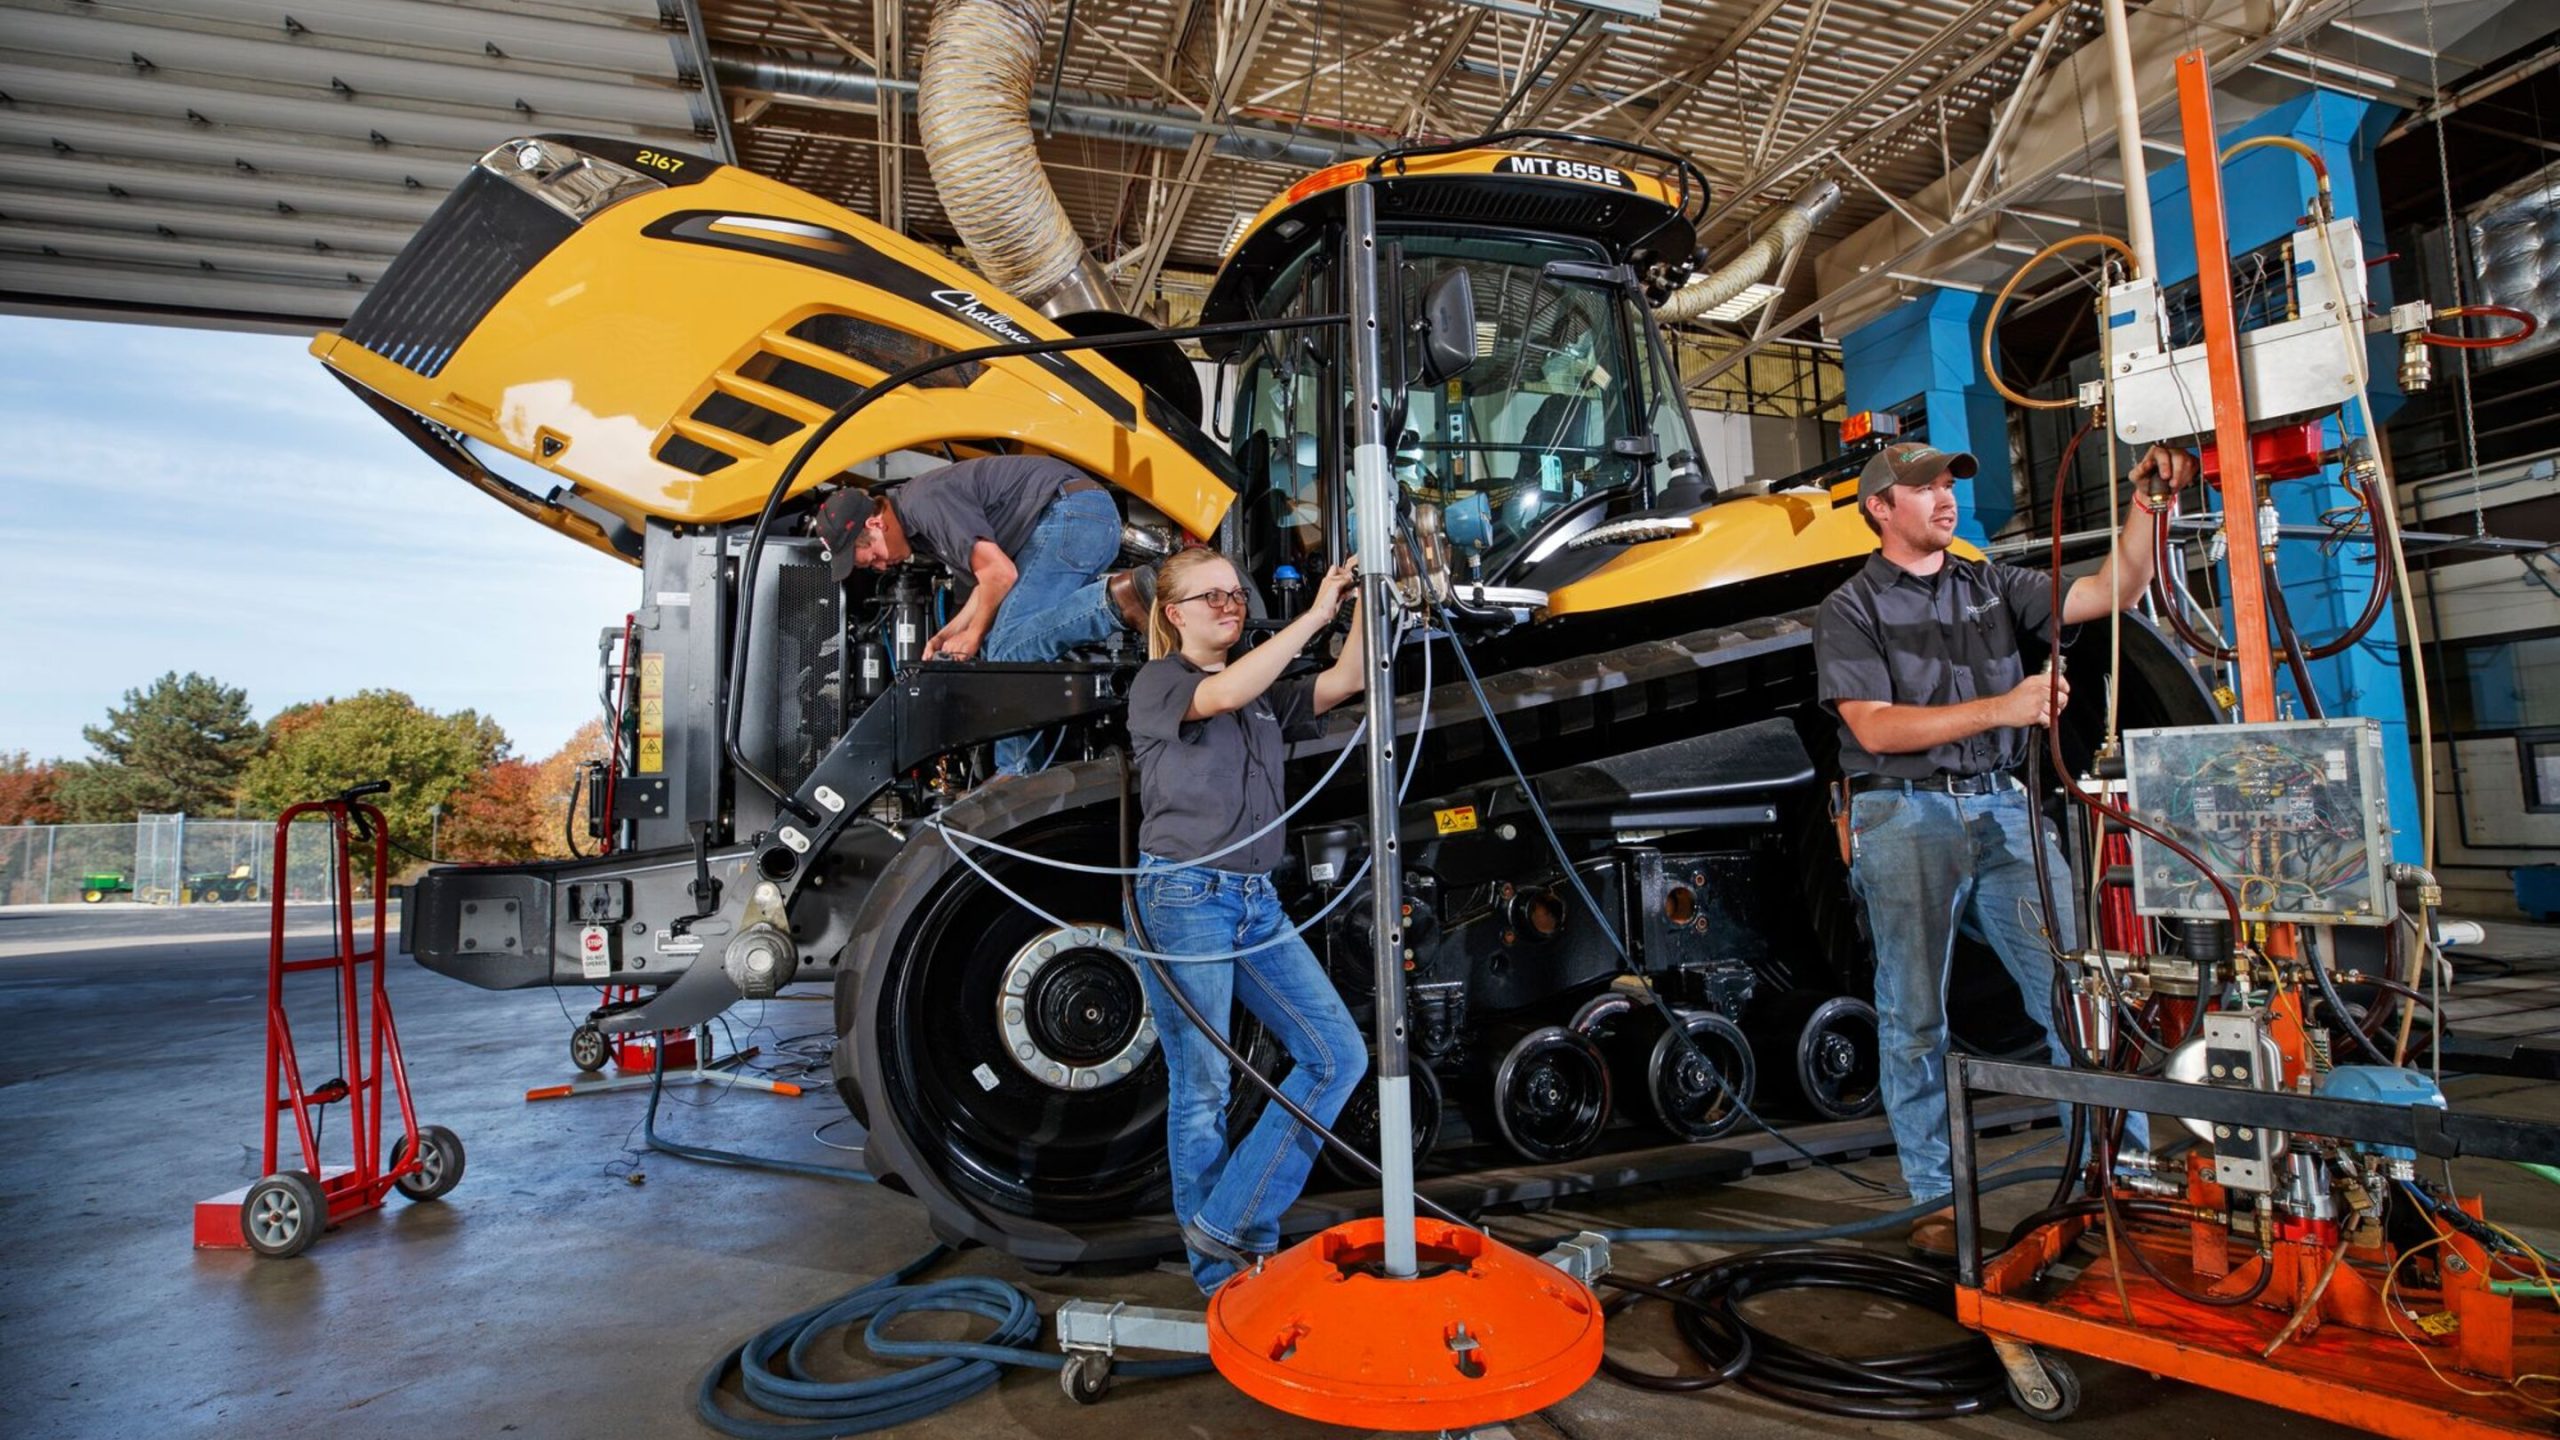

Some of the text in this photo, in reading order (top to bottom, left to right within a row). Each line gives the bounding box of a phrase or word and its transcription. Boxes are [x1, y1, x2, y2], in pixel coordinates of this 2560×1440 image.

[636, 150, 684, 173] 2167
[1511, 156, 1622, 186] MT 855E
[931, 290, 1033, 345] Challeng
